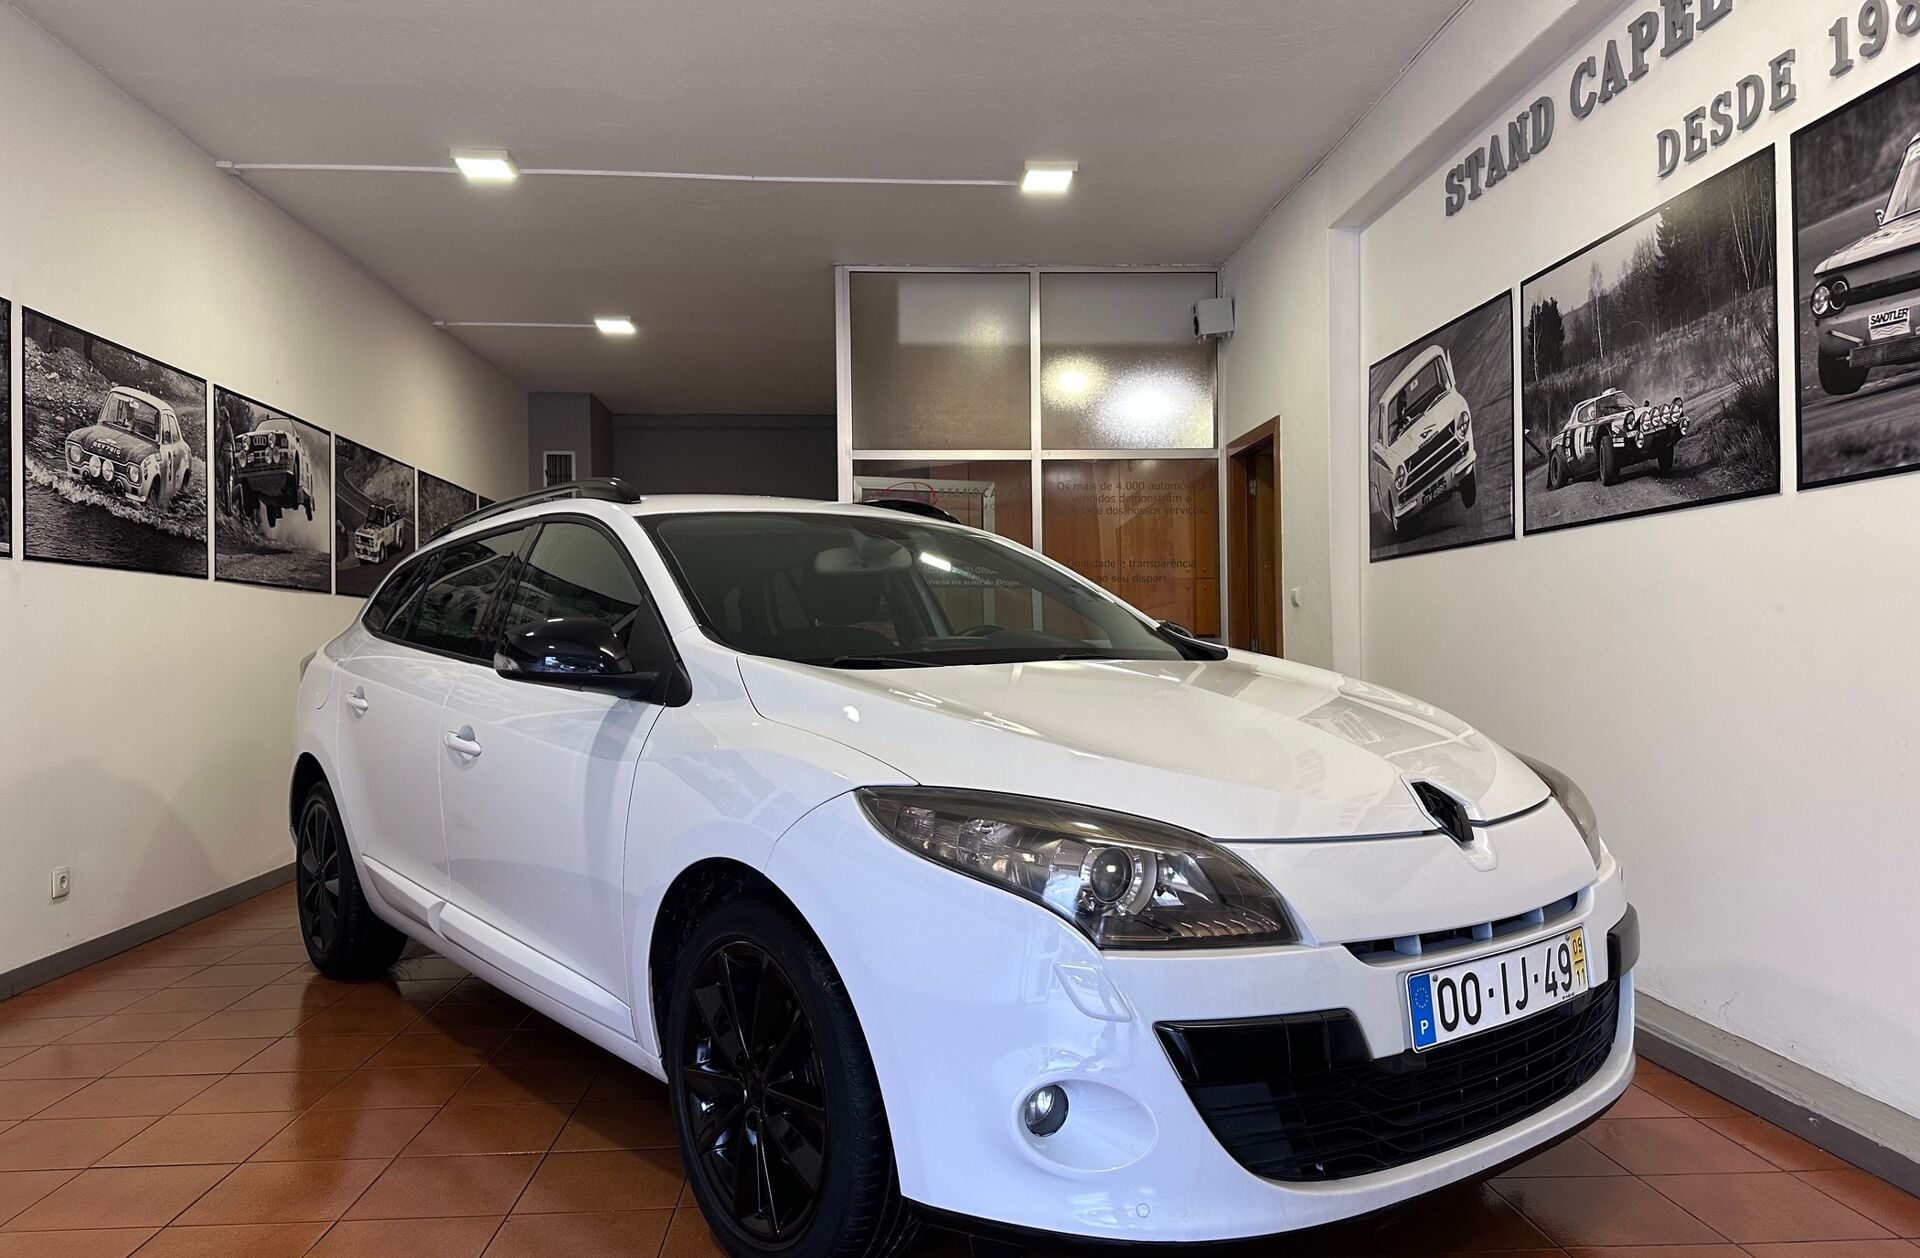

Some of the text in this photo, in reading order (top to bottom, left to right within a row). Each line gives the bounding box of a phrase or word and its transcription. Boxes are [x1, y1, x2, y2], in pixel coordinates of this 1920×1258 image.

[1657, 49, 1797, 178] DESDE
[1445, 96, 1555, 217] STAND
[1870, 307, 1909, 326] SANDTLER
[1056, 481, 1071, 491] Os
[1073, 481, 1097, 491] mais
[1100, 481, 1113, 491] de
[1148, 480, 1208, 491] automóvs
[1106, 506, 1124, 515] dos
[1129, 558, 1197, 570] transparência
[1112, 575, 1129, 583] seu
[1572, 937, 1583, 955] 09
[1420, 1020, 1429, 1035] P
